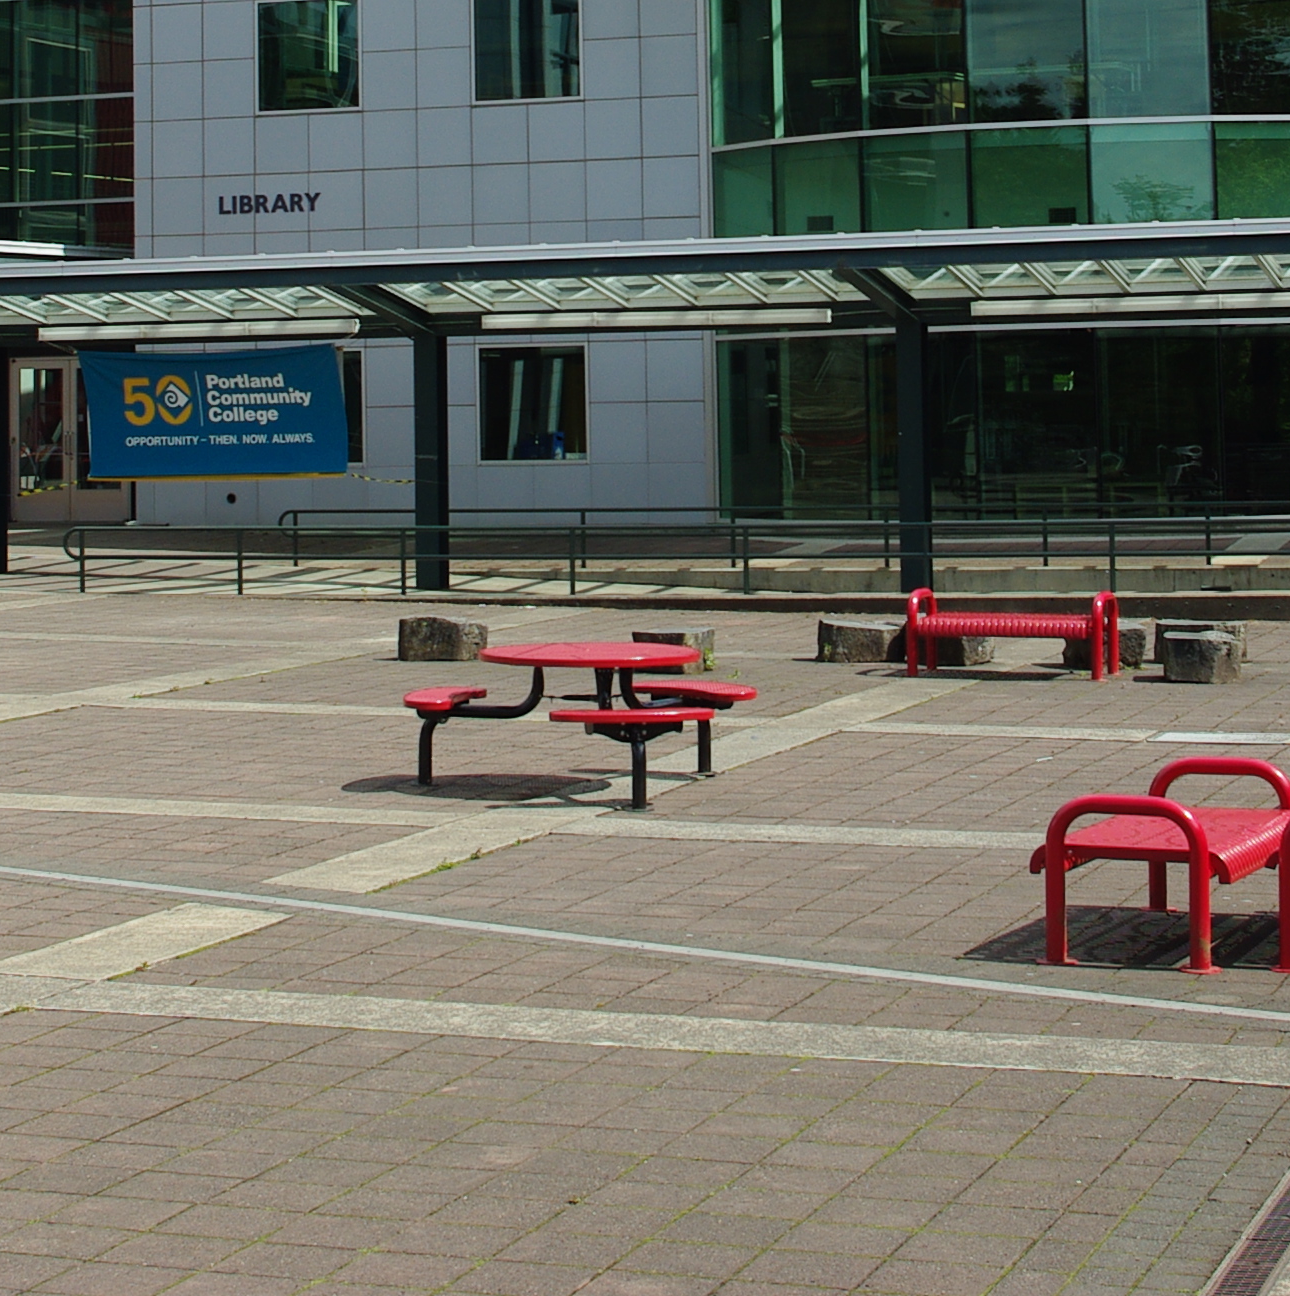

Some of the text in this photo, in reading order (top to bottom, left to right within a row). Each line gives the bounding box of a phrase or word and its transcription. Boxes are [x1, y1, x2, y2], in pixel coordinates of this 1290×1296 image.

[218, 192, 321, 215] LIBRARY
[205, 372, 285, 389] Portland
[123, 374, 193, 426] 50
[207, 387, 312, 406] Community
[208, 406, 279, 425] College
[125, 435, 199, 447] OPPORTUNITY
[209, 434, 240, 445] THEN.
[242, 433, 269, 444] NOW.
[272, 432, 315, 444] ALWAYS.
